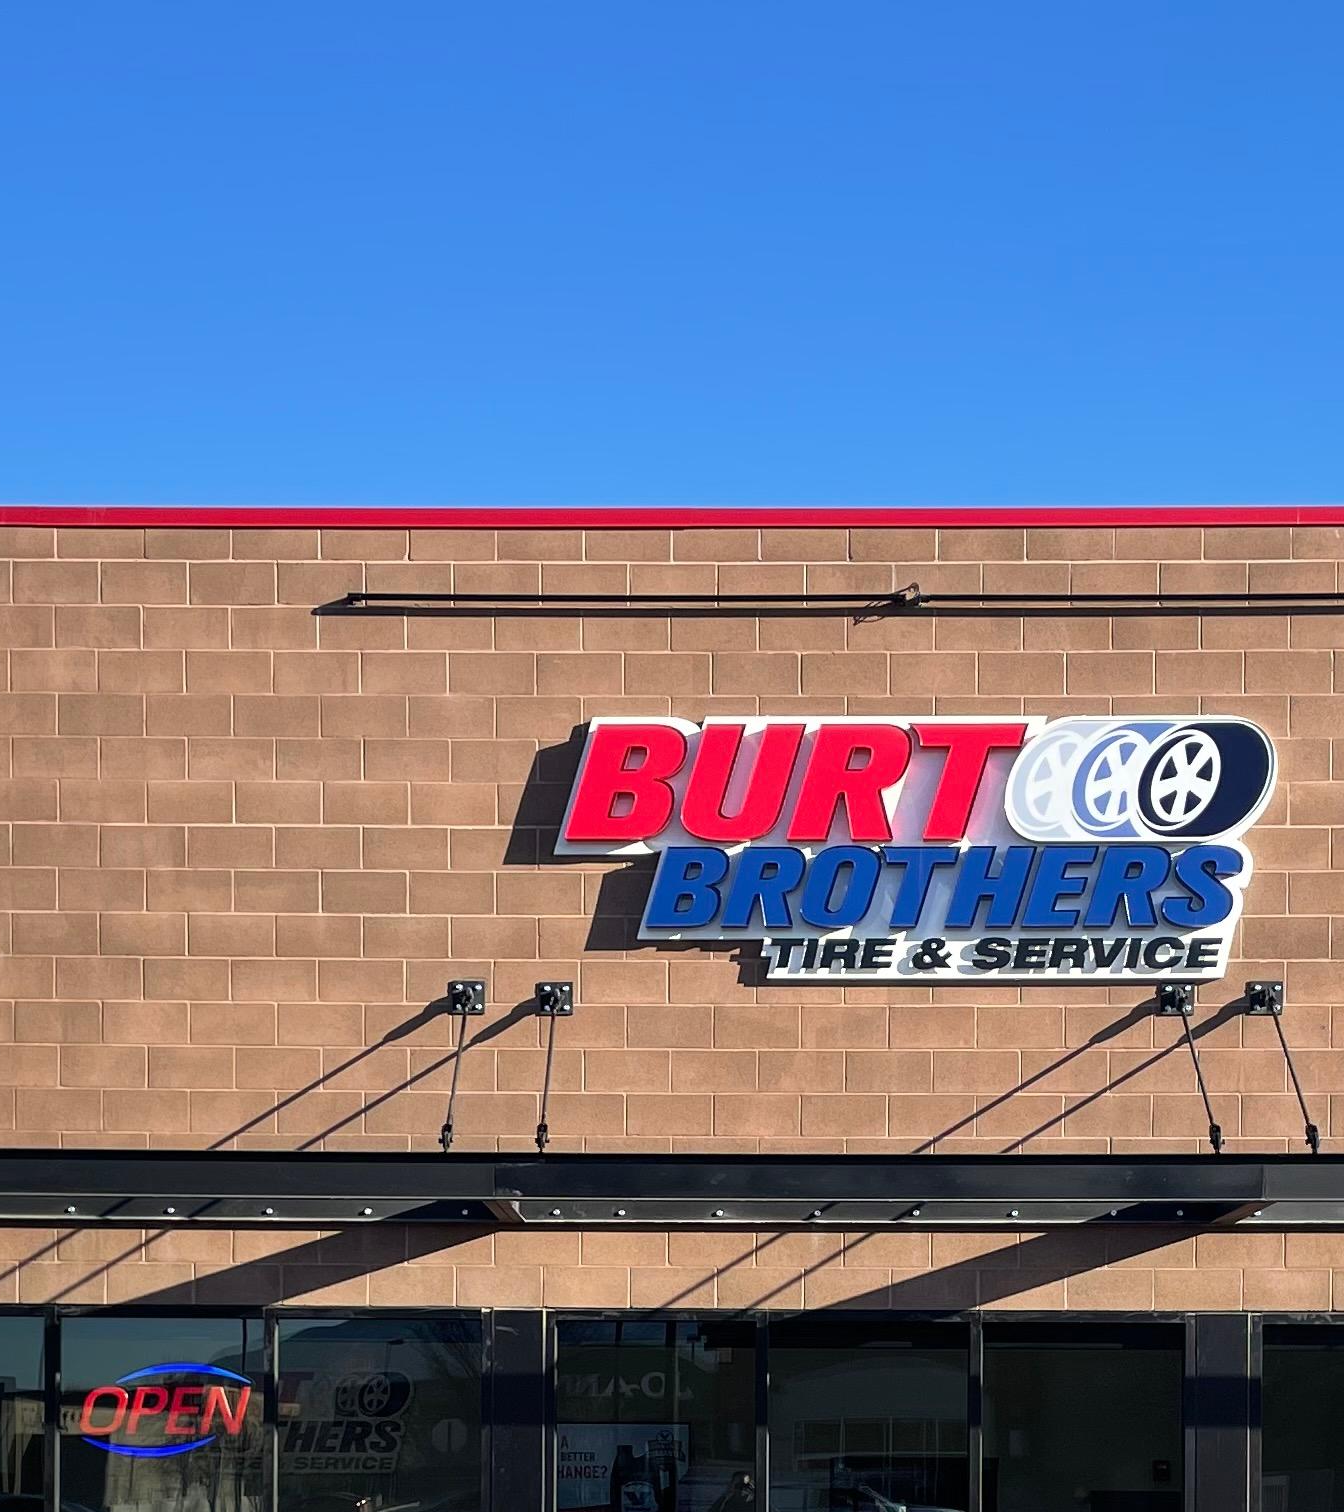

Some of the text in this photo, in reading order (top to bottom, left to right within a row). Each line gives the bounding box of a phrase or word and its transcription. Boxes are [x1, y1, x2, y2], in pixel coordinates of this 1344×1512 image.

[564, 722, 1028, 842] BURT
[645, 845, 1244, 929] BROTHERS
[771, 936, 1223, 970] TIRE & SERVICE
[78, 1385, 251, 1437] OPEN
[294, 1456, 394, 1470] SERVICE
[557, 1464, 608, 1479] HANGE?
[560, 1451, 596, 1462] BETTER
